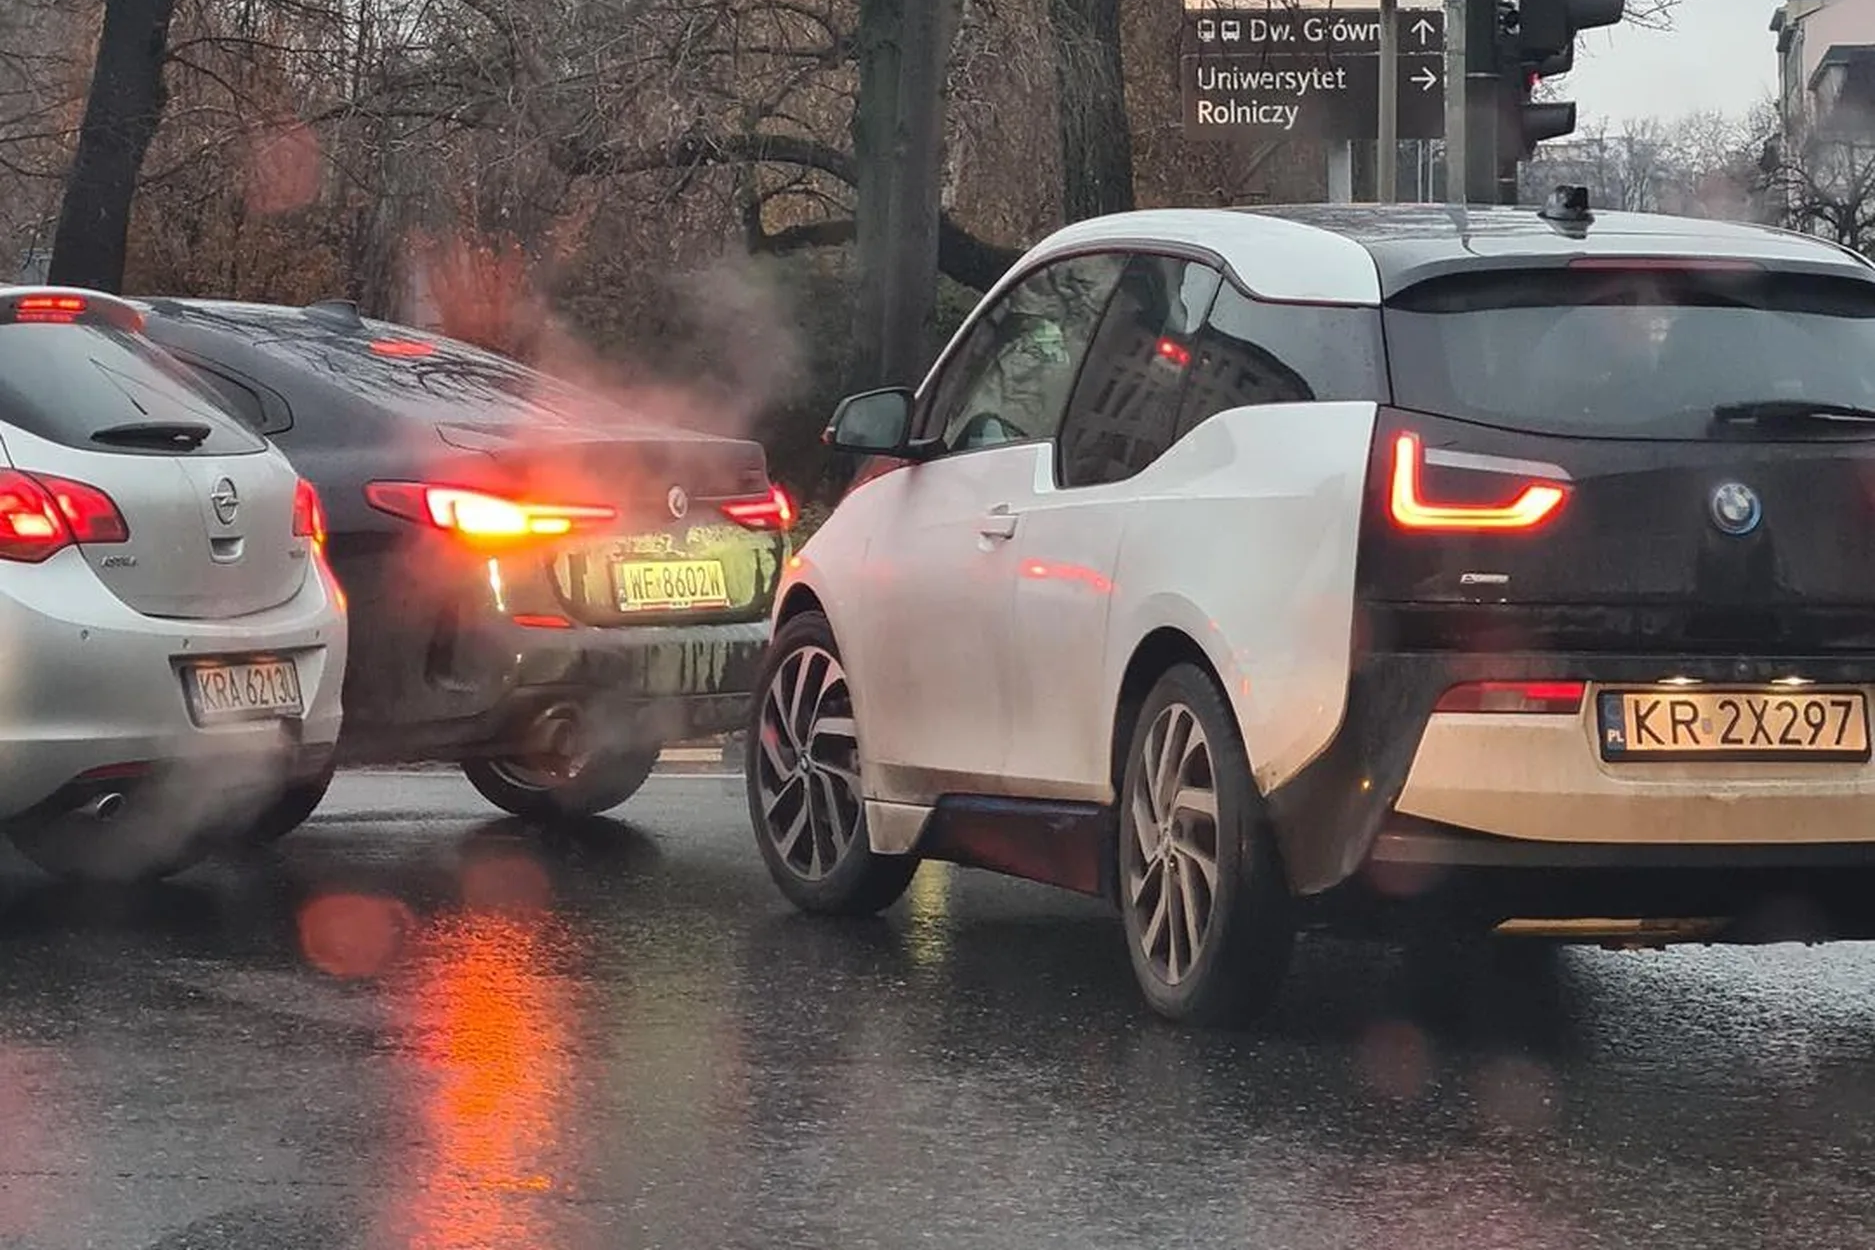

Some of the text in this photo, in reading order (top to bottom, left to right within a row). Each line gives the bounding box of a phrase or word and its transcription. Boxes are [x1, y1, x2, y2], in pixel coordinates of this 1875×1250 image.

[1250, 17, 1382, 42] Dw. Gówn
[1197, 66, 1347, 96] Uniwersytet
[1198, 99, 1299, 130] Rolniczy
[629, 567, 653, 600] WF
[199, 669, 242, 710] KRA
[1607, 729, 1624, 742] PL
[1634, 699, 1853, 746] KR 2X297
